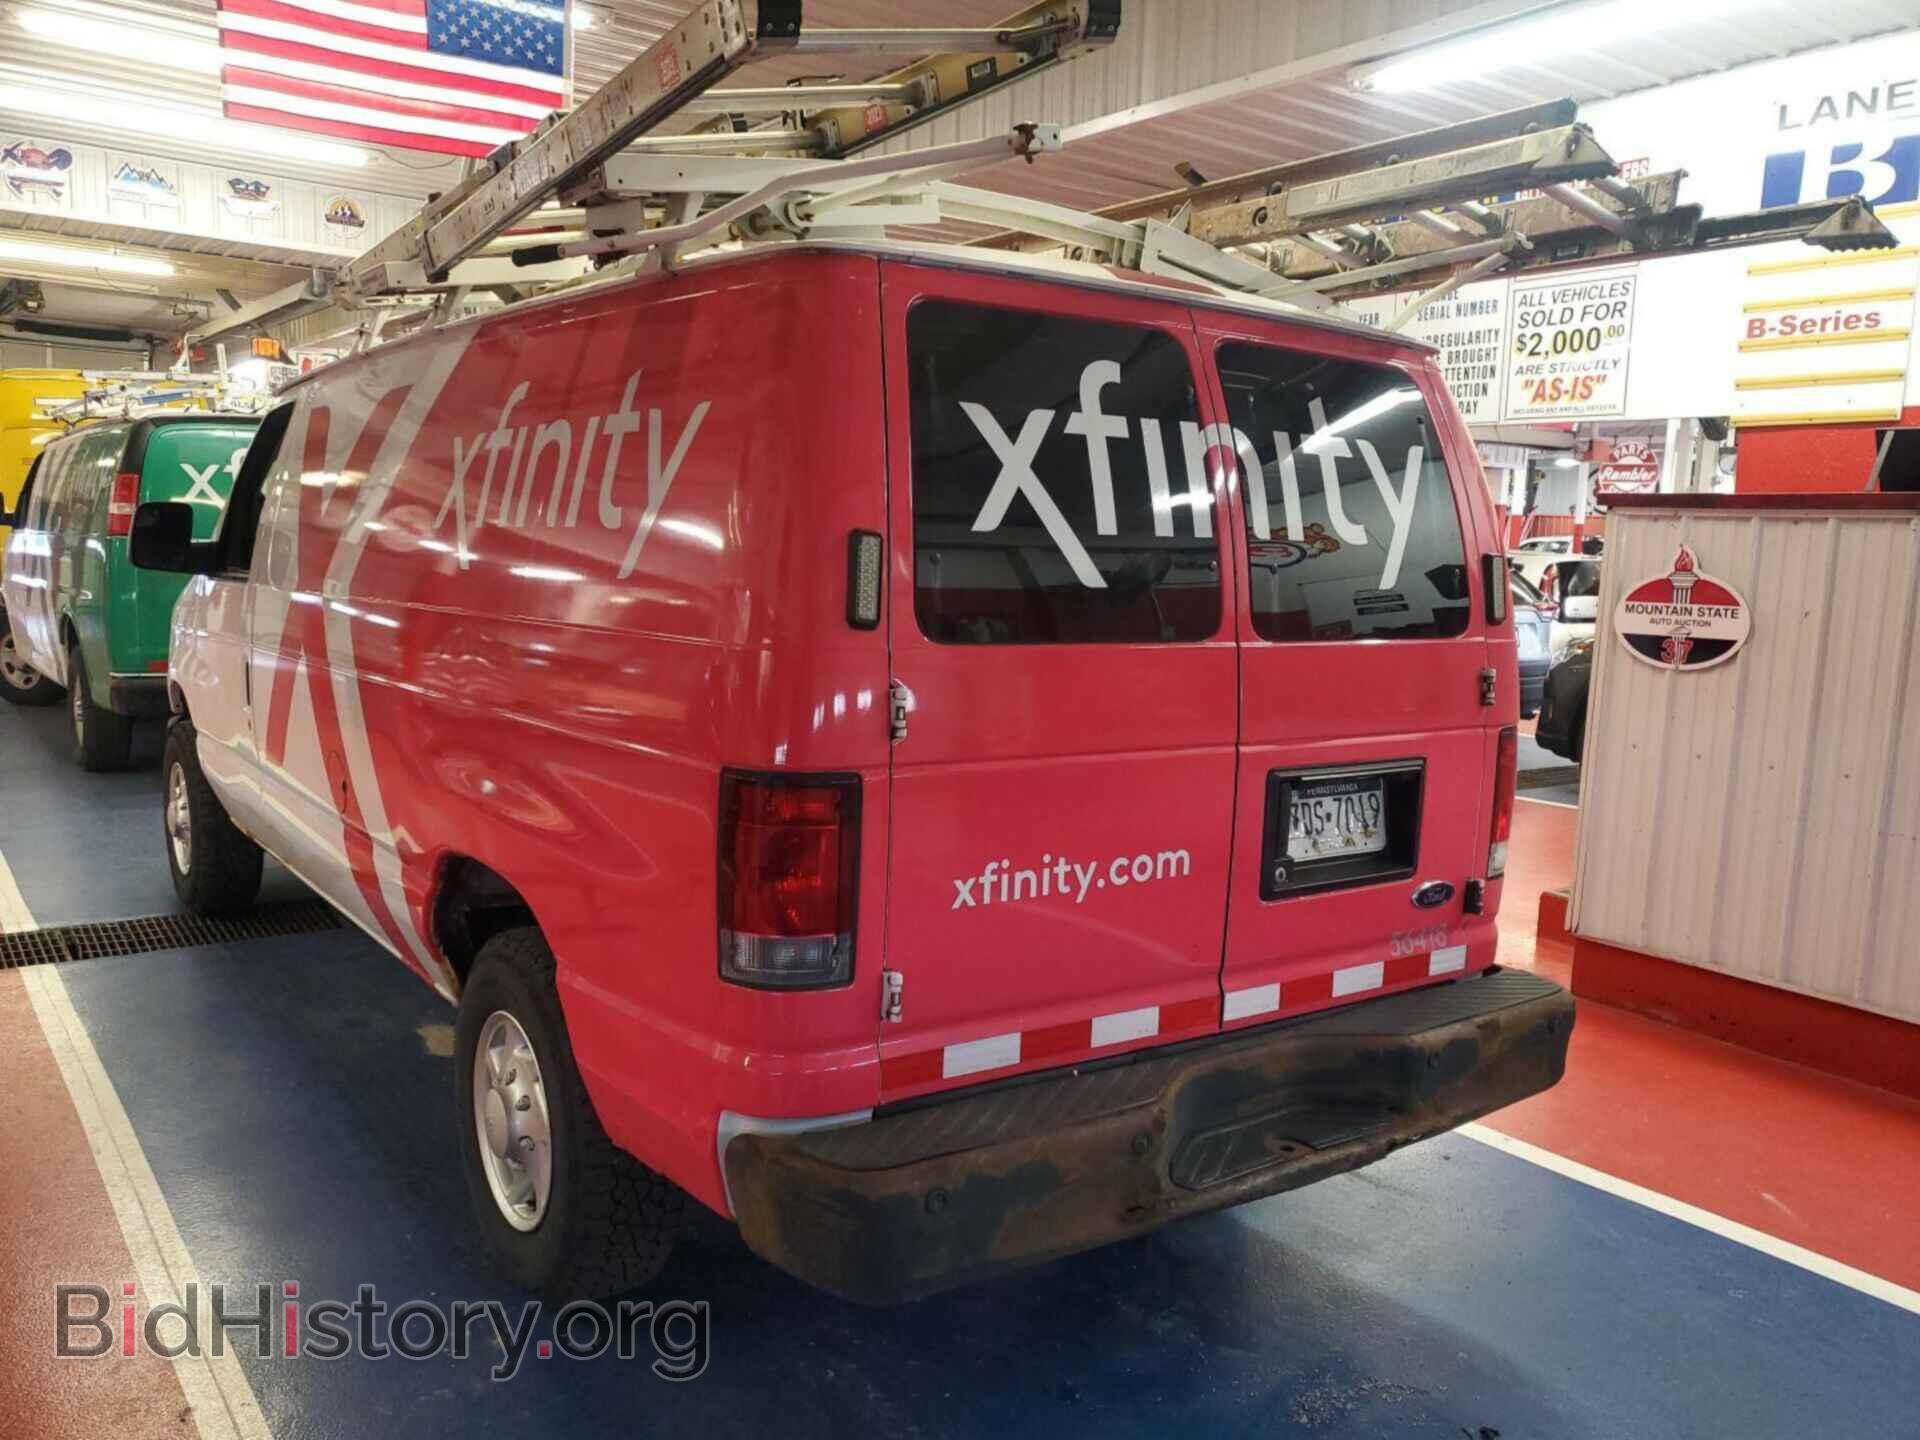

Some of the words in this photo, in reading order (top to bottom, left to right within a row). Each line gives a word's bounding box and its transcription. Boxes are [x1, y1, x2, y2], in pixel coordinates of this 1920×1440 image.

[1778, 80, 1917, 131] LANE
[1518, 291, 1545, 308] ALL
[1551, 281, 1631, 305] VEHICLES
[1417, 304, 1450, 322] SERIAL
[1456, 299, 1498, 317] NUMBER
[1518, 306, 1574, 329] SOLD
[1580, 301, 1626, 323] FOR
[1747, 311, 1881, 339] B-Series
[1447, 347, 1498, 365] BROUGHT
[1514, 364, 1544, 376] ARE
[1549, 357, 1621, 374] STRICTLY
[1524, 374, 1607, 404] "AS-IS"
[1613, 444, 1649, 461] PARTS
[432, 369, 711, 580] xfinity
[959, 360, 1424, 590] xfinity
[1625, 604, 1693, 617] MOUNTAIN
[1697, 607, 1740, 619] STATE
[1649, 618, 1672, 626] AUTO
[1675, 619, 1711, 627] AUCTION
[951, 849, 1190, 909] xfinity.com
